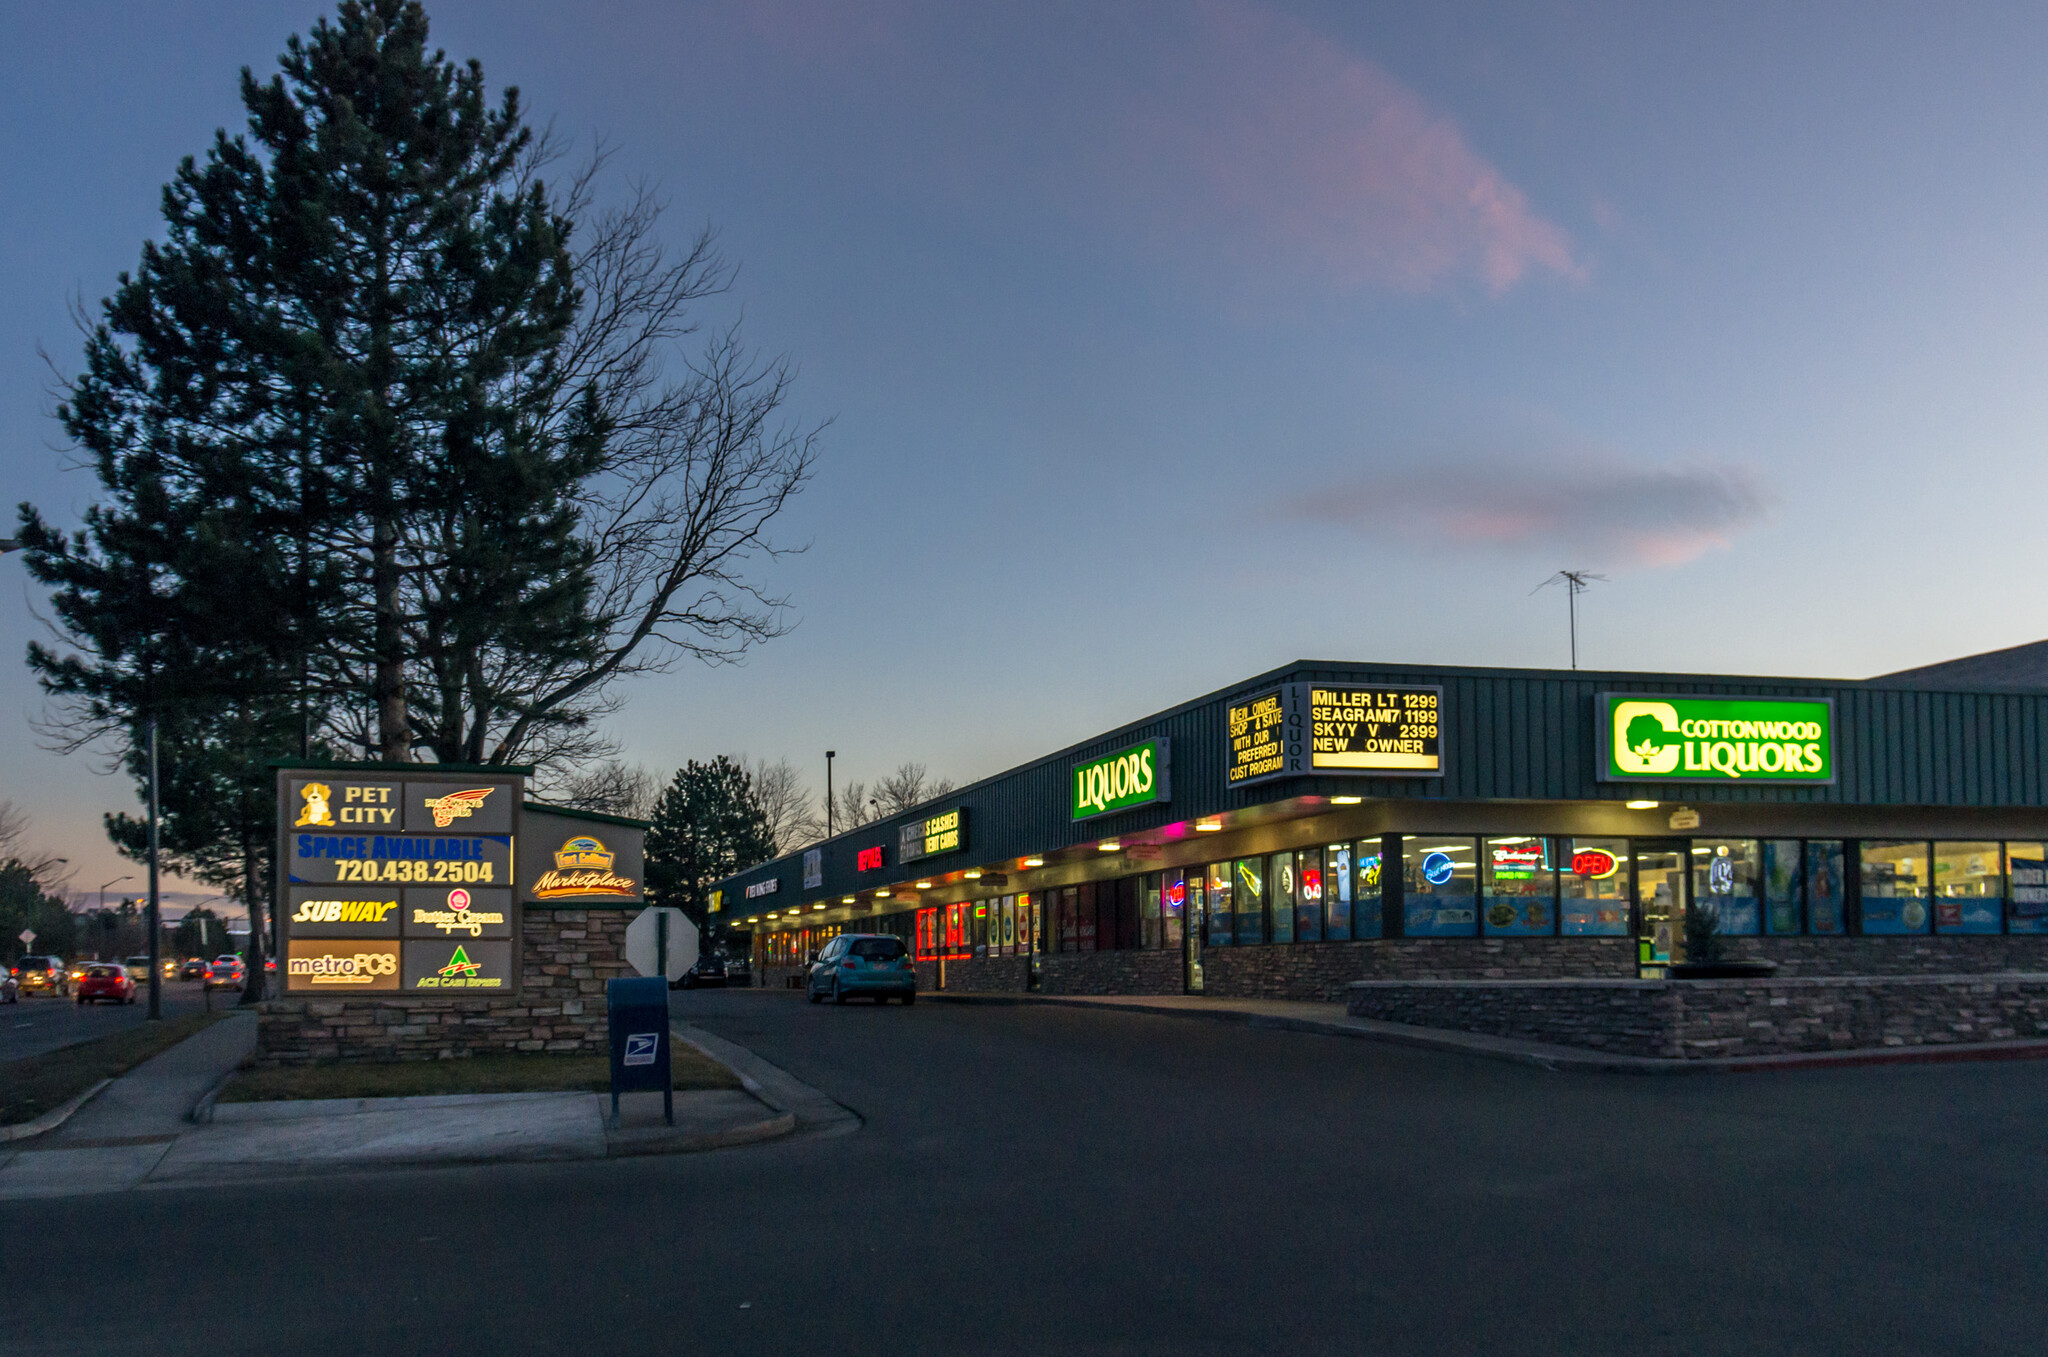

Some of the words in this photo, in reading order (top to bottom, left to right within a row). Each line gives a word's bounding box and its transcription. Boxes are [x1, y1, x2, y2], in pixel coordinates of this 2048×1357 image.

[1234, 706, 1248, 721] NEW
[1252, 697, 1277, 716] OWNER
[1315, 691, 1371, 707] MILLER
[1377, 693, 1398, 707] LT
[1402, 694, 1438, 708] 1299
[1230, 721, 1248, 738] SHOP
[1255, 717, 1261, 730] &
[1262, 710, 1283, 728] SAVE
[1404, 709, 1438, 724] 1199
[1288, 686, 1304, 771] LIQUOR
[1313, 722, 1358, 737] SKYY
[1367, 723, 1379, 737] V
[1399, 724, 1438, 739] 2399
[1681, 719, 1821, 740] COTTONWOOD
[1233, 735, 1251, 752] WITH
[1253, 729, 1270, 746] OUR
[1313, 737, 1349, 752] NEW
[1366, 738, 1424, 753] OWNER
[1238, 741, 1278, 764] PREFERRED
[1684, 741, 1823, 778] LIQUORS
[1077, 747, 1153, 811] LIQUORS
[1230, 764, 1248, 781] CUST
[1249, 755, 1283, 776] PROGRAM
[345, 787, 391, 803] PET
[339, 807, 397, 824] CITY
[931, 812, 958, 835] CASHED
[298, 834, 367, 859] SPACE
[371, 836, 483, 861] AVAILABLE
[925, 835, 939, 853] DEBIT
[940, 829, 958, 850] CARDS
[335, 860, 494, 883] 720.438.2504
[1572, 853, 1611, 875] OPEN
[533, 871, 636, 892] Marketplace
[291, 900, 398, 923] SUBWAY
[413, 909, 457, 923] Butter
[457, 909, 504, 924] Cream
[288, 953, 397, 975] metroPCS
[416, 977, 440, 988] ACE
